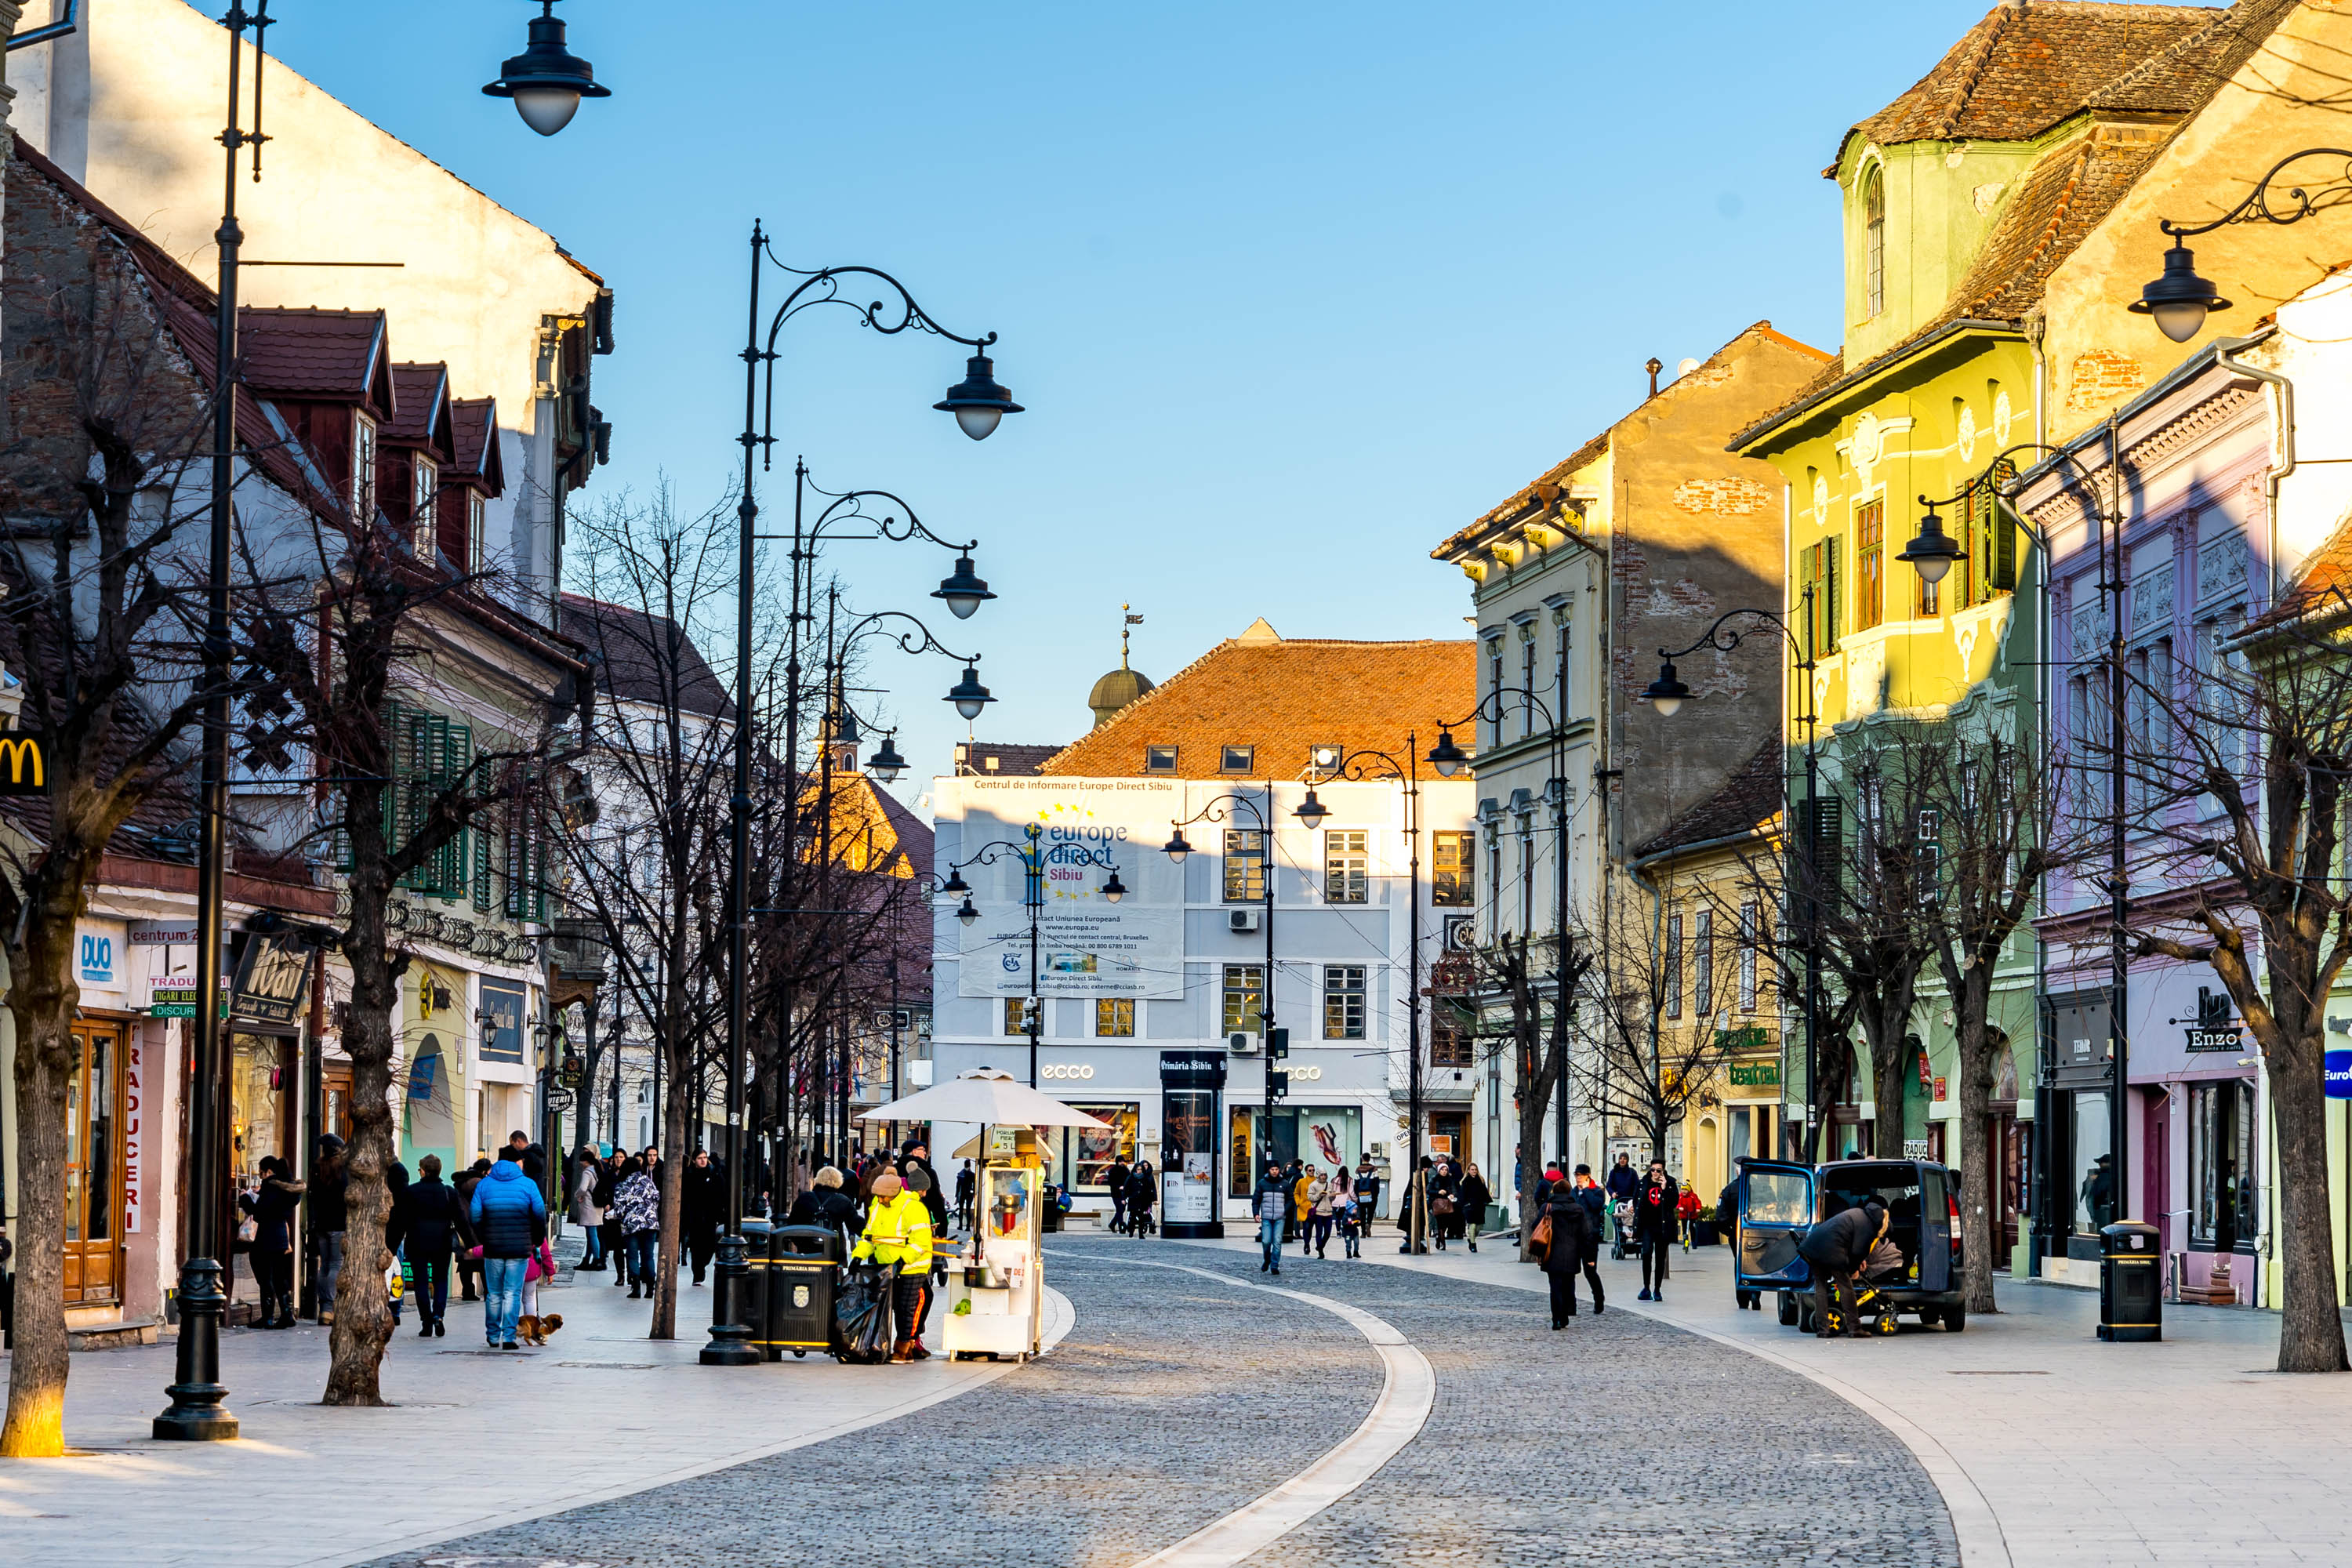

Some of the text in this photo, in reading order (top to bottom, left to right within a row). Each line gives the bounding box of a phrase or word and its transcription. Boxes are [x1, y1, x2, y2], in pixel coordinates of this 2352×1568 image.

[975, 780, 1172, 792] Centrul de Informare Europe Direct Sibiu
[1050, 826, 1127, 847] europe
[1050, 845, 1112, 864] direct
[1050, 869, 1083, 880] Sibiu
[133, 930, 187, 942] centrum
[82, 935, 111, 969] DUO
[150, 978, 226, 986] TRADUI
[2191, 1031, 2238, 1046] Enzo
[1189, 1059, 1212, 1071] Sibiu
[1041, 1065, 1094, 1080] ecco
